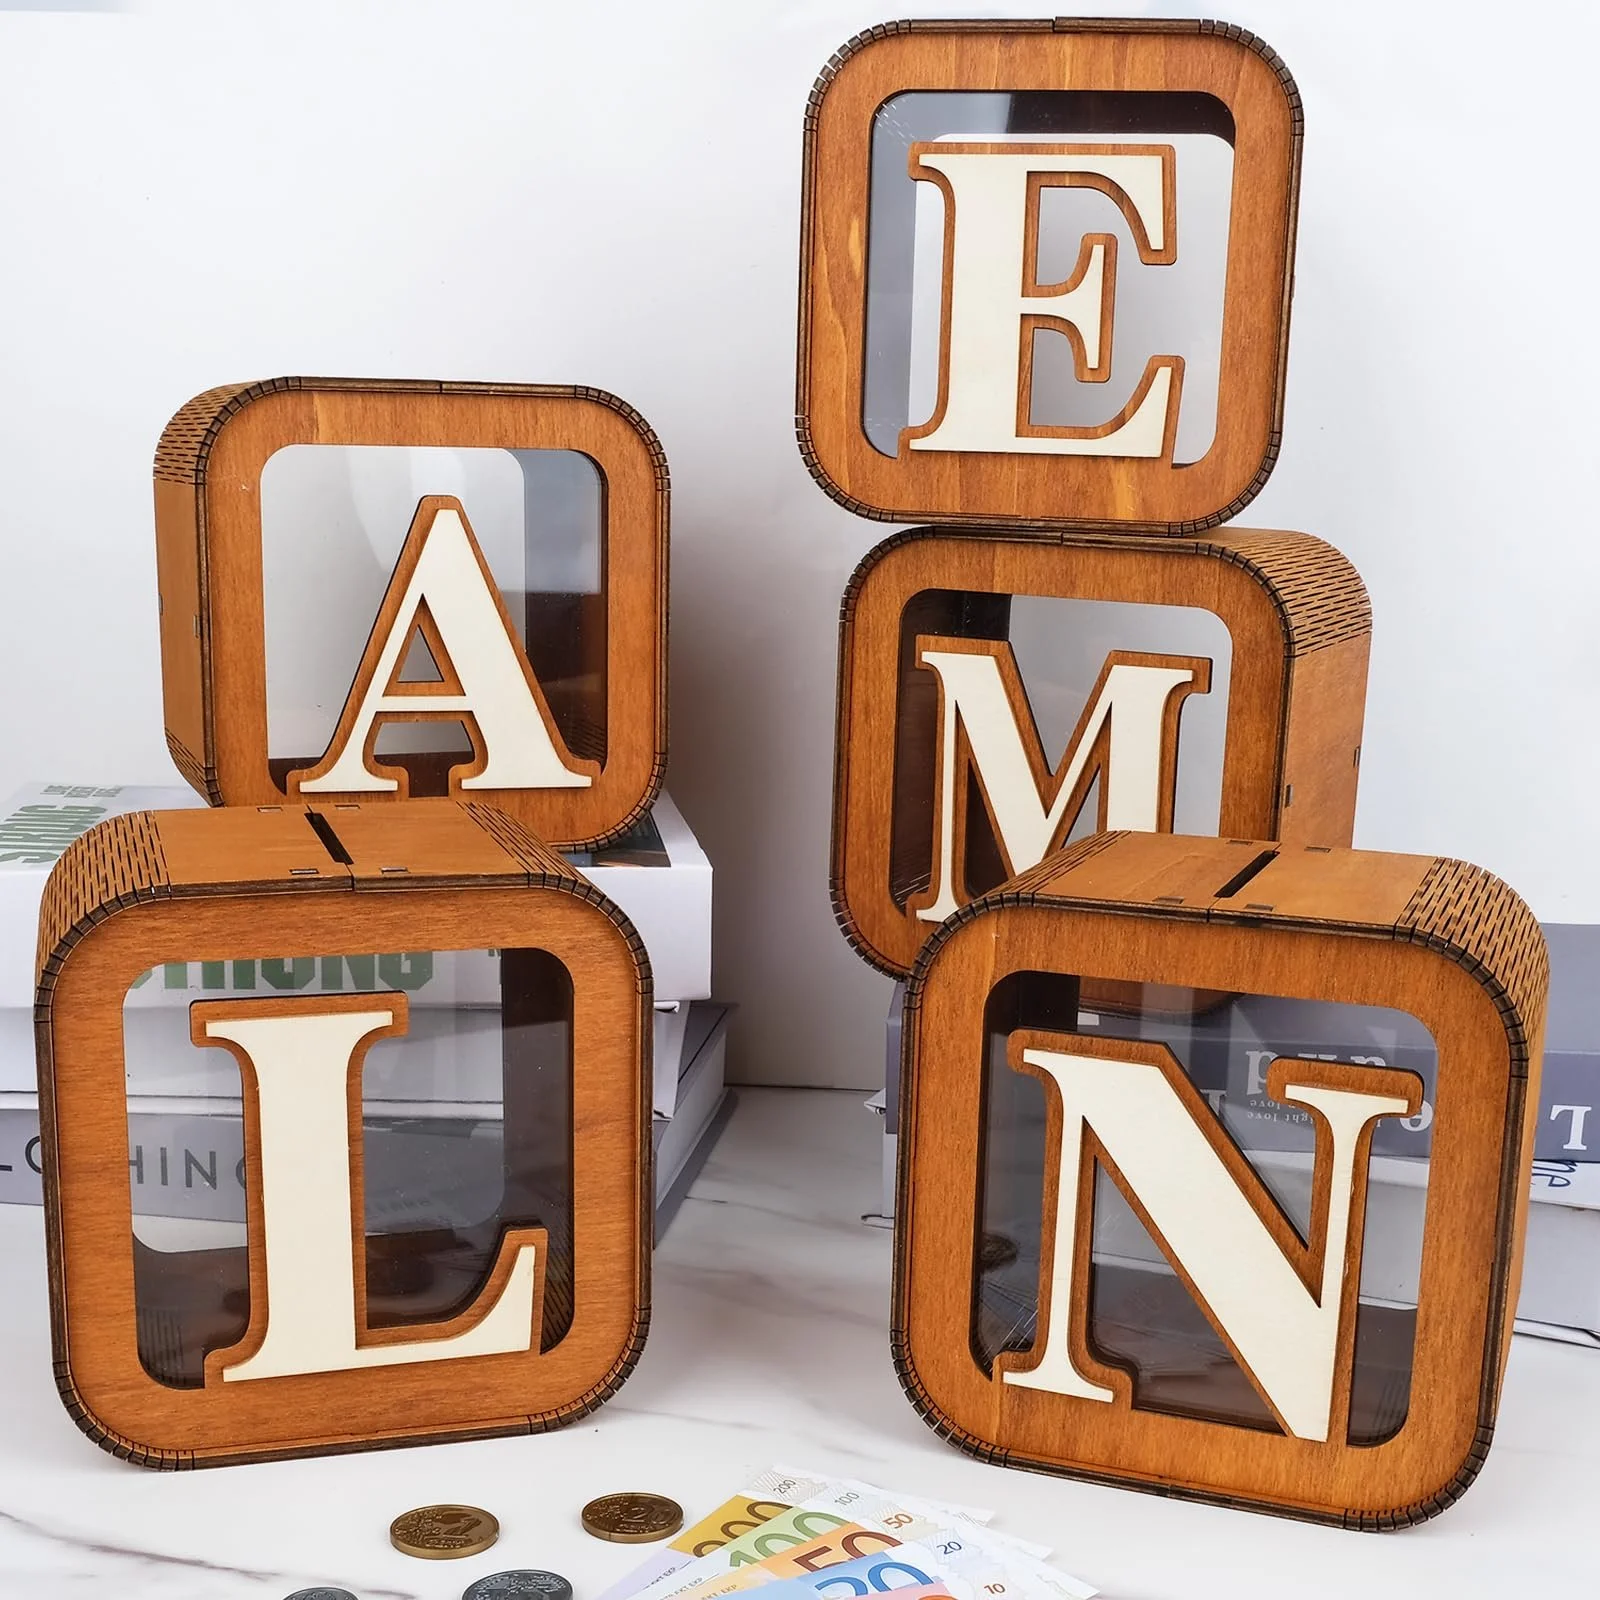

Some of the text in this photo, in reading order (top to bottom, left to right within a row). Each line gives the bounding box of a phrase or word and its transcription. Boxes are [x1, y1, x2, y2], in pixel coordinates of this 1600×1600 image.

[909, 153, 1175, 458] E
[299, 508, 593, 793] A
[915, 650, 1194, 922] M
[204, 1009, 538, 1383] L
[1002, 1047, 1411, 1442] N
[772, 1478, 797, 1496] 200
[833, 1490, 861, 1507] 100
[882, 1512, 914, 1530] 50
[936, 1540, 963, 1556] 20
[983, 1582, 1007, 1596] 10
